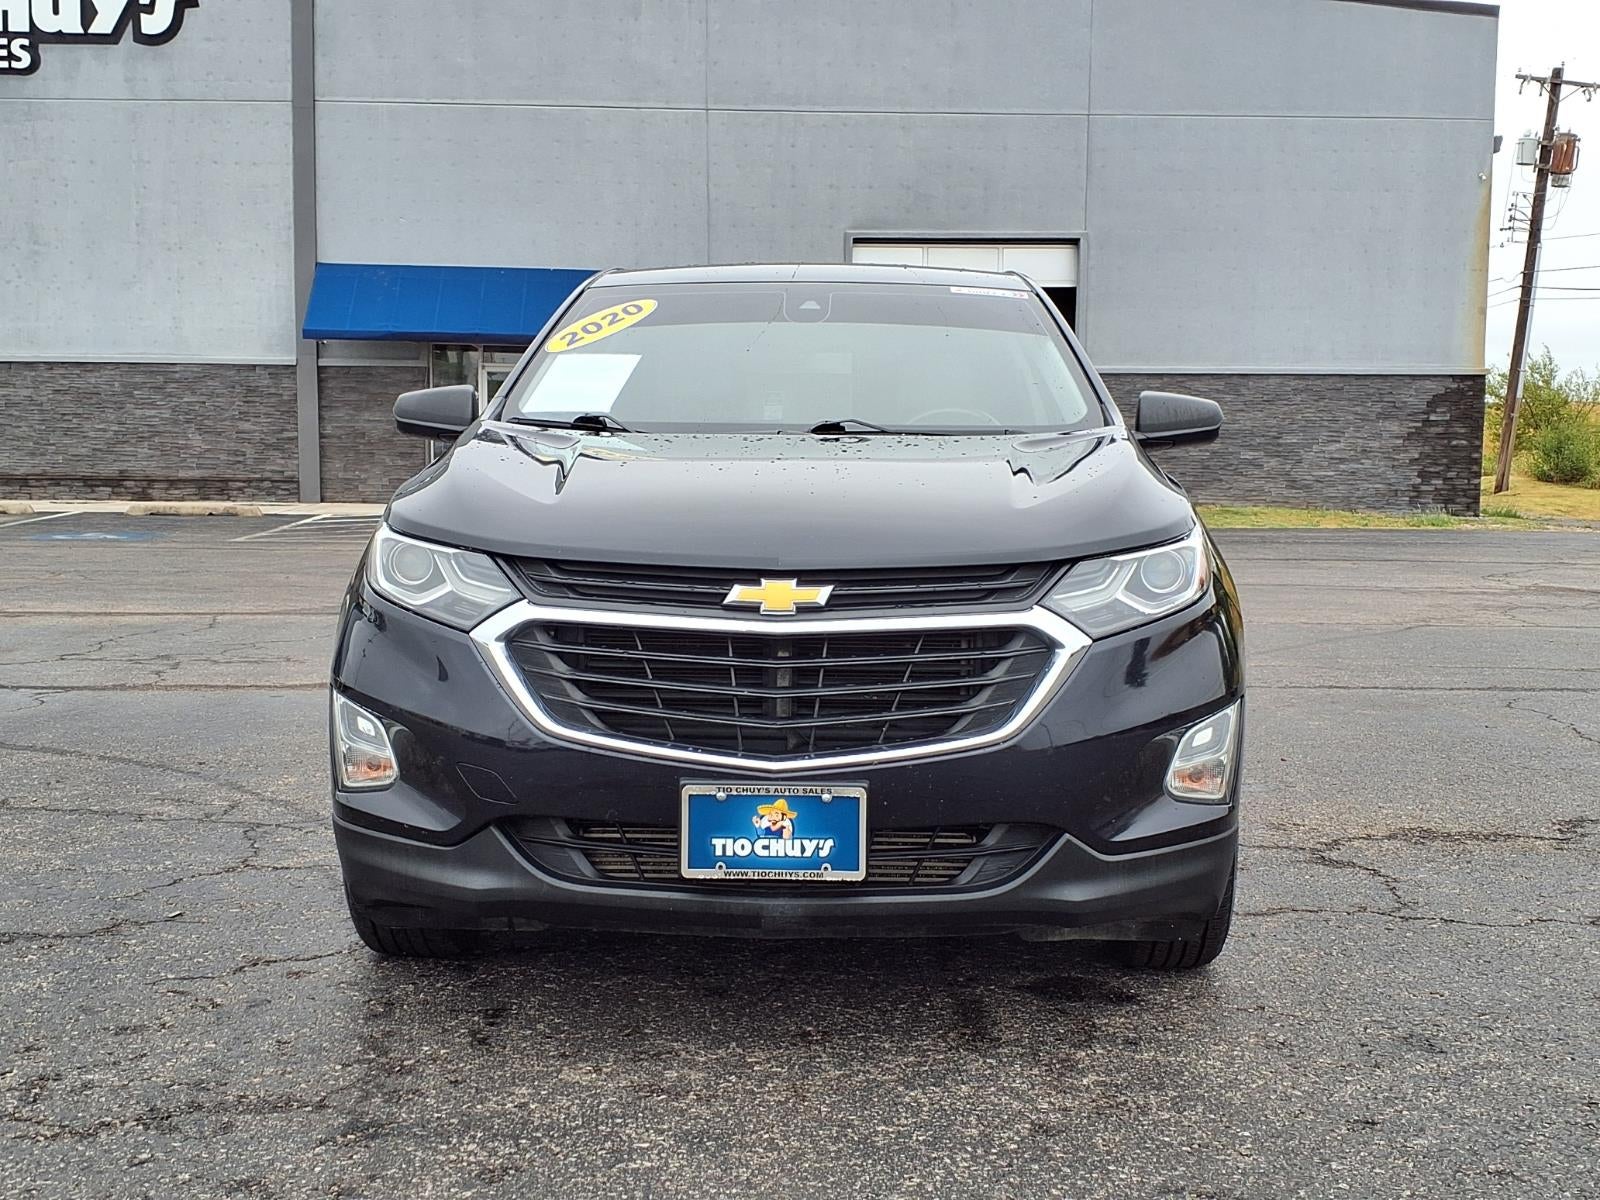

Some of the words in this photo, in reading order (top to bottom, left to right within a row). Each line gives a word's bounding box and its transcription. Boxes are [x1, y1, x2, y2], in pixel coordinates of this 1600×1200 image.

[559, 303, 644, 347] 2020
[715, 786, 733, 794] TIO
[735, 786, 771, 794] CHUY'S
[773, 787, 800, 795] AUTO
[802, 787, 833, 795] SALES
